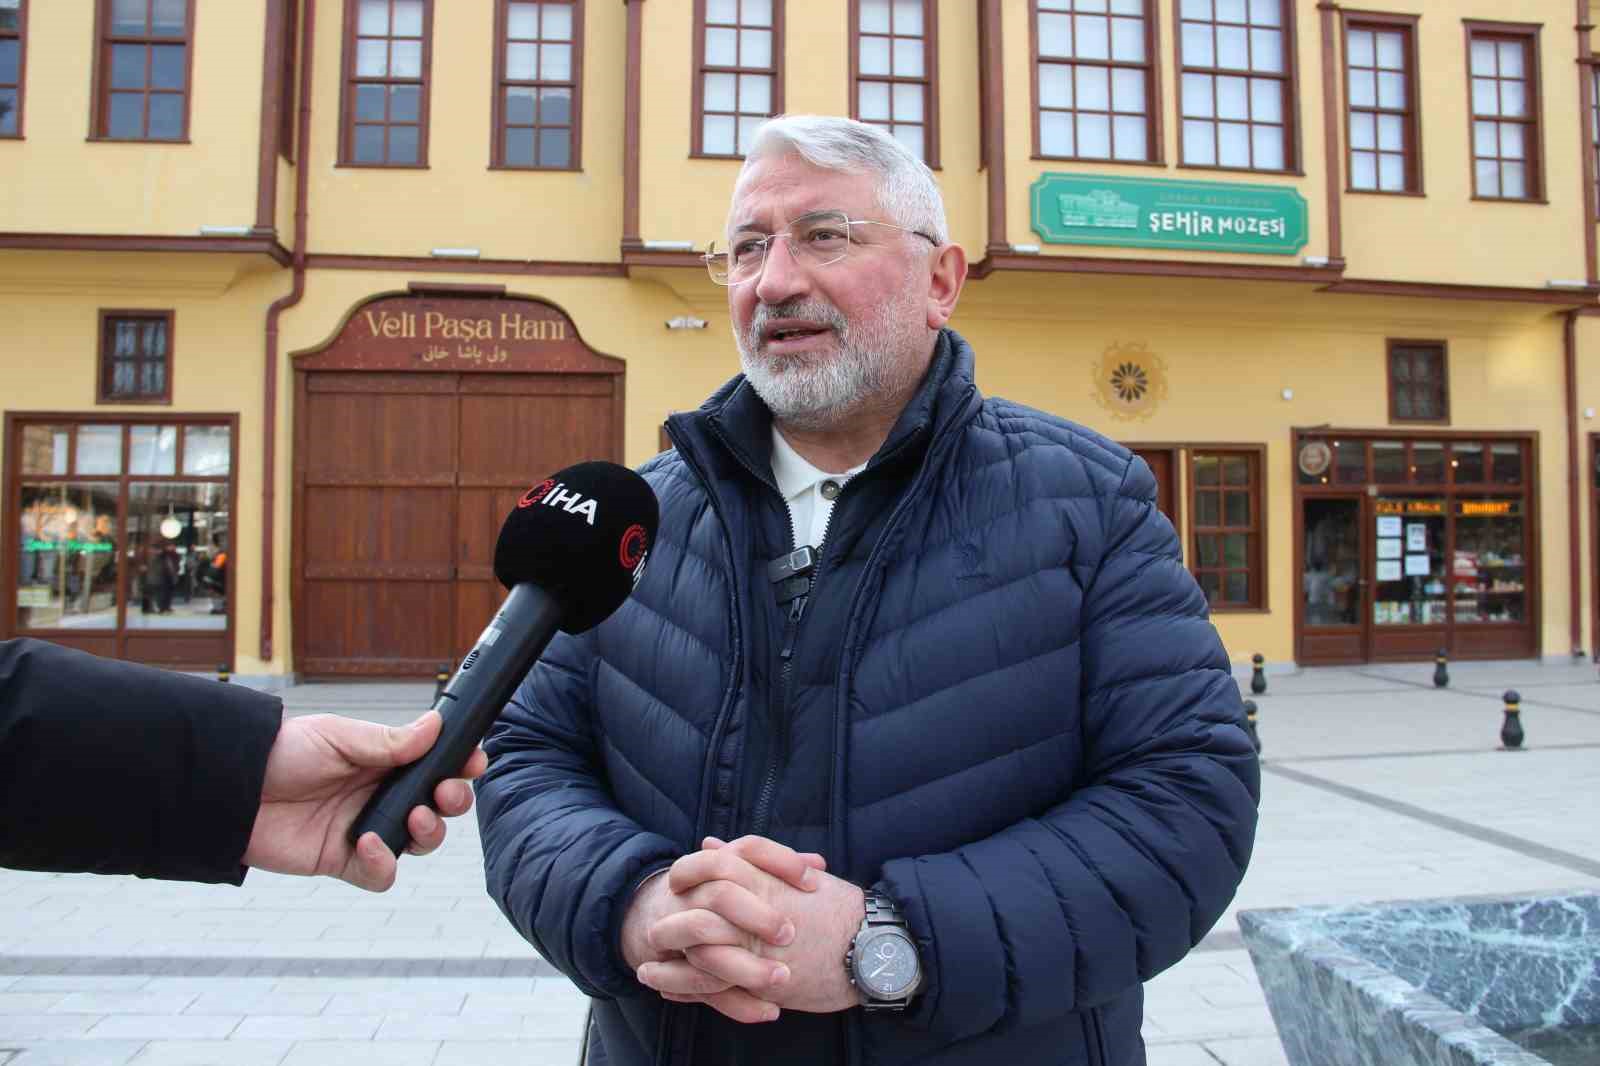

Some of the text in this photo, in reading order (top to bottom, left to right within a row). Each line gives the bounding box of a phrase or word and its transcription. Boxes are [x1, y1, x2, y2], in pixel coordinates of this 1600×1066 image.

[425, 313, 493, 343] Paşa
[501, 314, 565, 340] Hanı
[541, 483, 598, 525] İHA
